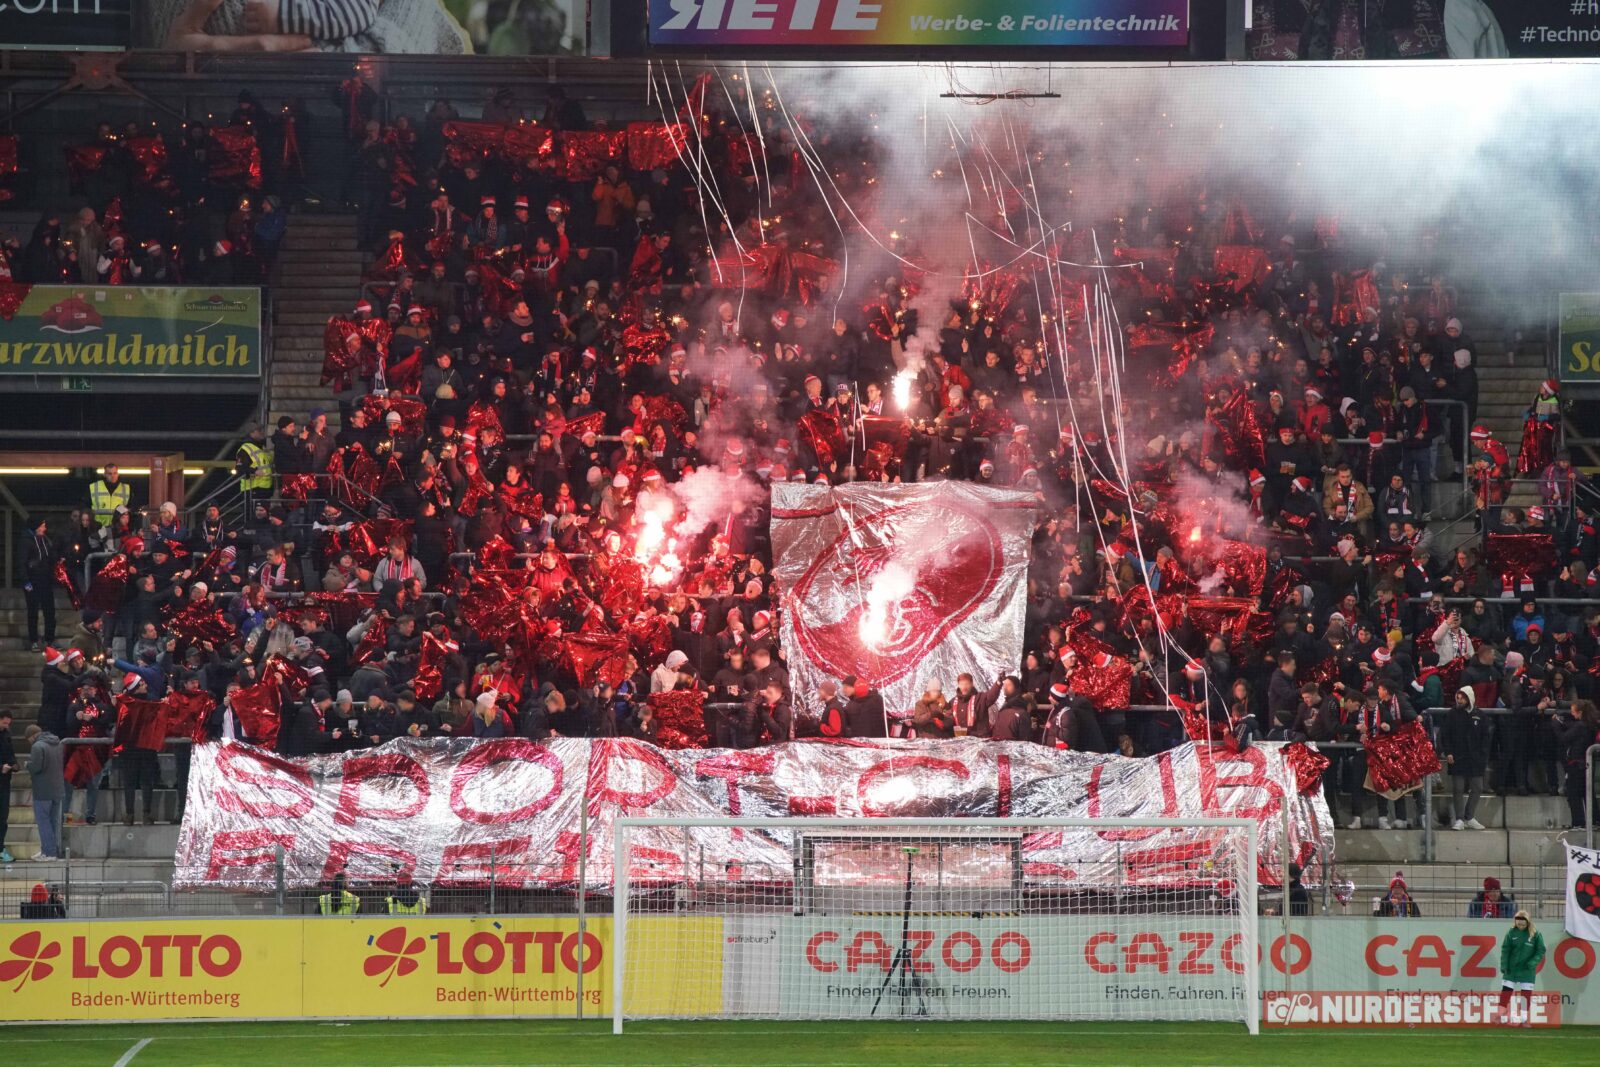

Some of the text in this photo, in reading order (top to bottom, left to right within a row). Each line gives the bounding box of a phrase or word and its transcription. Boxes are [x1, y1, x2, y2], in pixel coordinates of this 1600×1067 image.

[910, 15, 1180, 31] Werbe- & Folientechnik
[72, 934, 242, 978] LOTTO
[437, 931, 603, 975] LOTTO
[805, 931, 1031, 973] CAZOO
[1084, 932, 1312, 975] CAZOO
[1365, 935, 1596, 979] CAZO
[71, 990, 241, 1008] Baden-Württemberg
[436, 987, 602, 1005] Baden-Württemberg
[1105, 985, 1164, 1000] Finden.
[1168, 985, 1228, 1000] Fahren.
